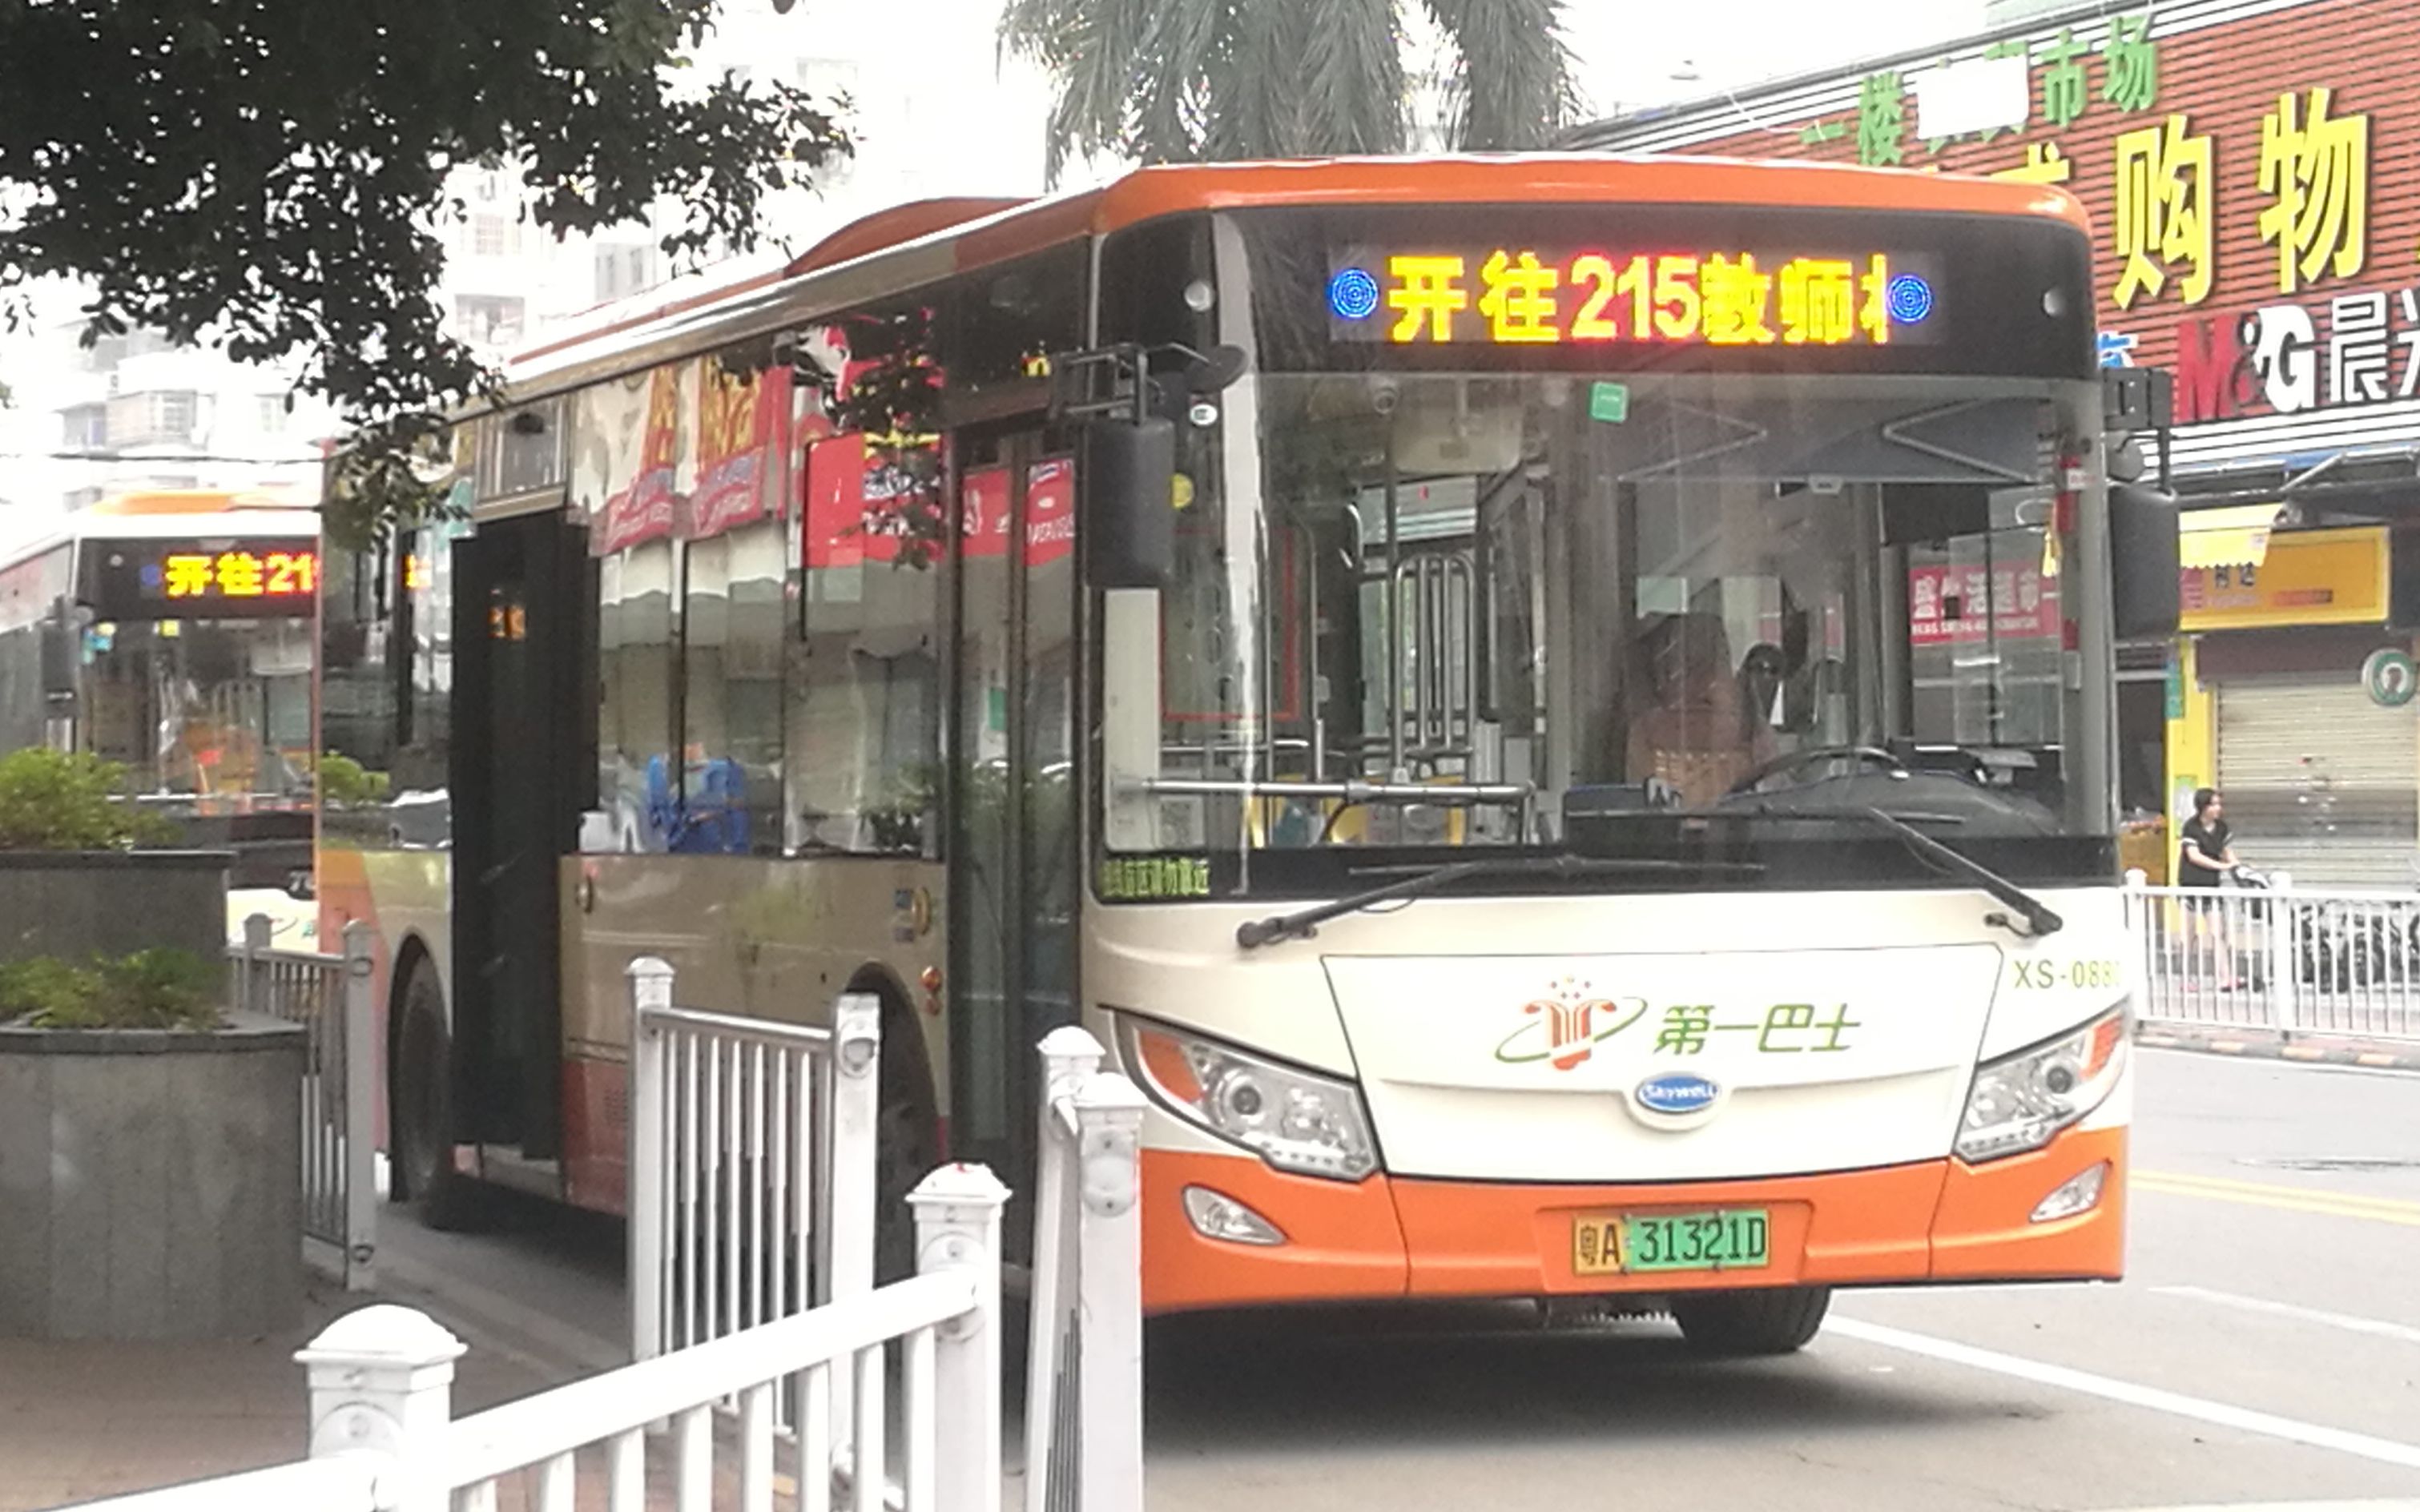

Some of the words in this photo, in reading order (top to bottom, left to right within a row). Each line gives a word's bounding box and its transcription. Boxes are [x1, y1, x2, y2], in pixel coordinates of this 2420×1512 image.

[1800, 14, 2156, 165] 一楼市场
[1990, 86, 2369, 311] 购物
[2178, 304, 2316, 423] M&G
[165, 552, 319, 596] 开往21
[2014, 959, 2120, 989] XS-088
[1653, 1003, 1861, 1056] 第一巴士
